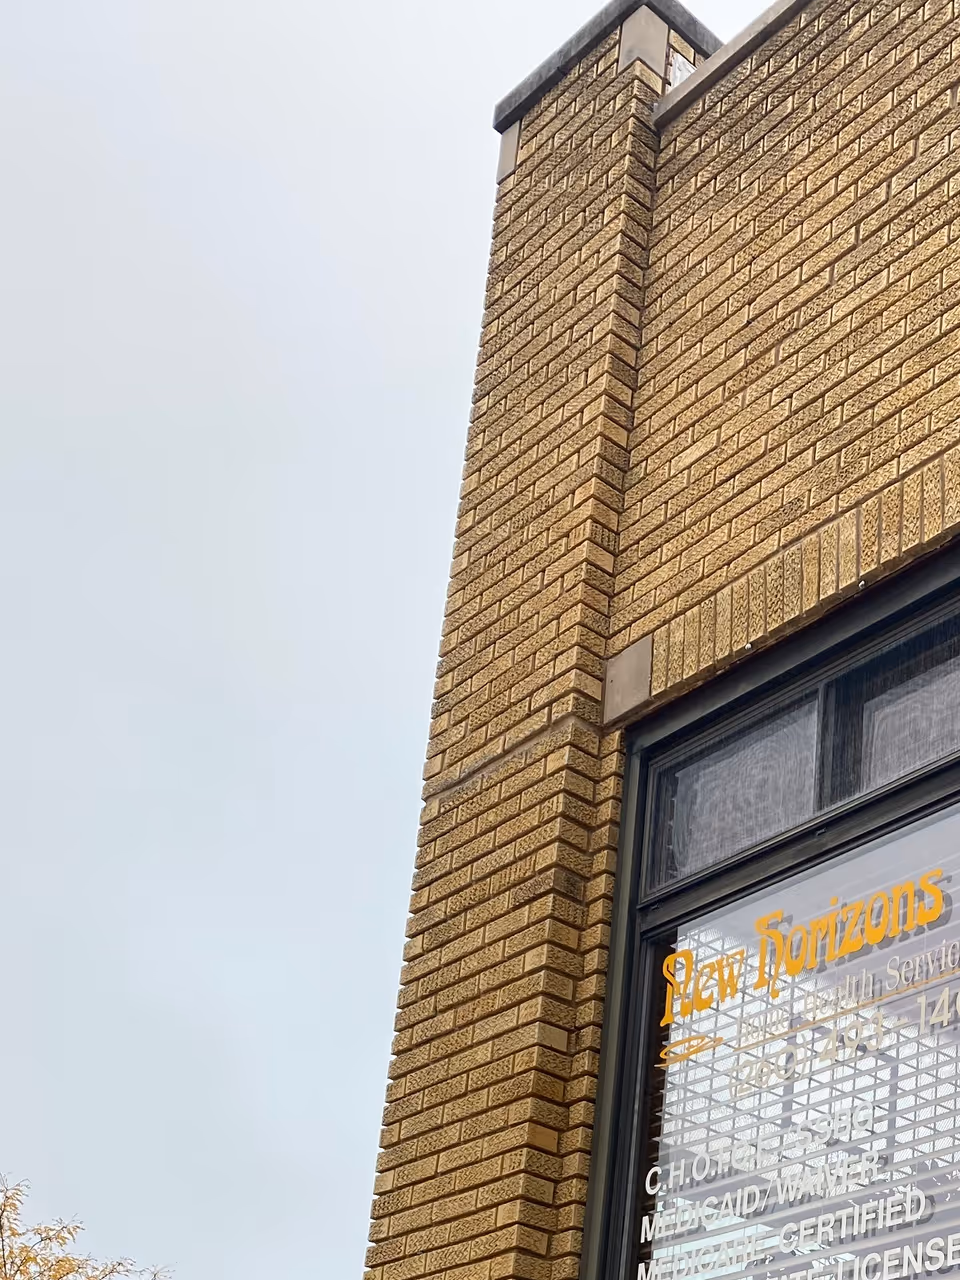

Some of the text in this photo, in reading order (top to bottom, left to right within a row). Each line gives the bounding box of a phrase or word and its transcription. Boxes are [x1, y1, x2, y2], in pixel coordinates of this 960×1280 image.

[660, 869, 943, 1027] New Horizons
[779, 1187, 926, 1254] CERTIFIED
